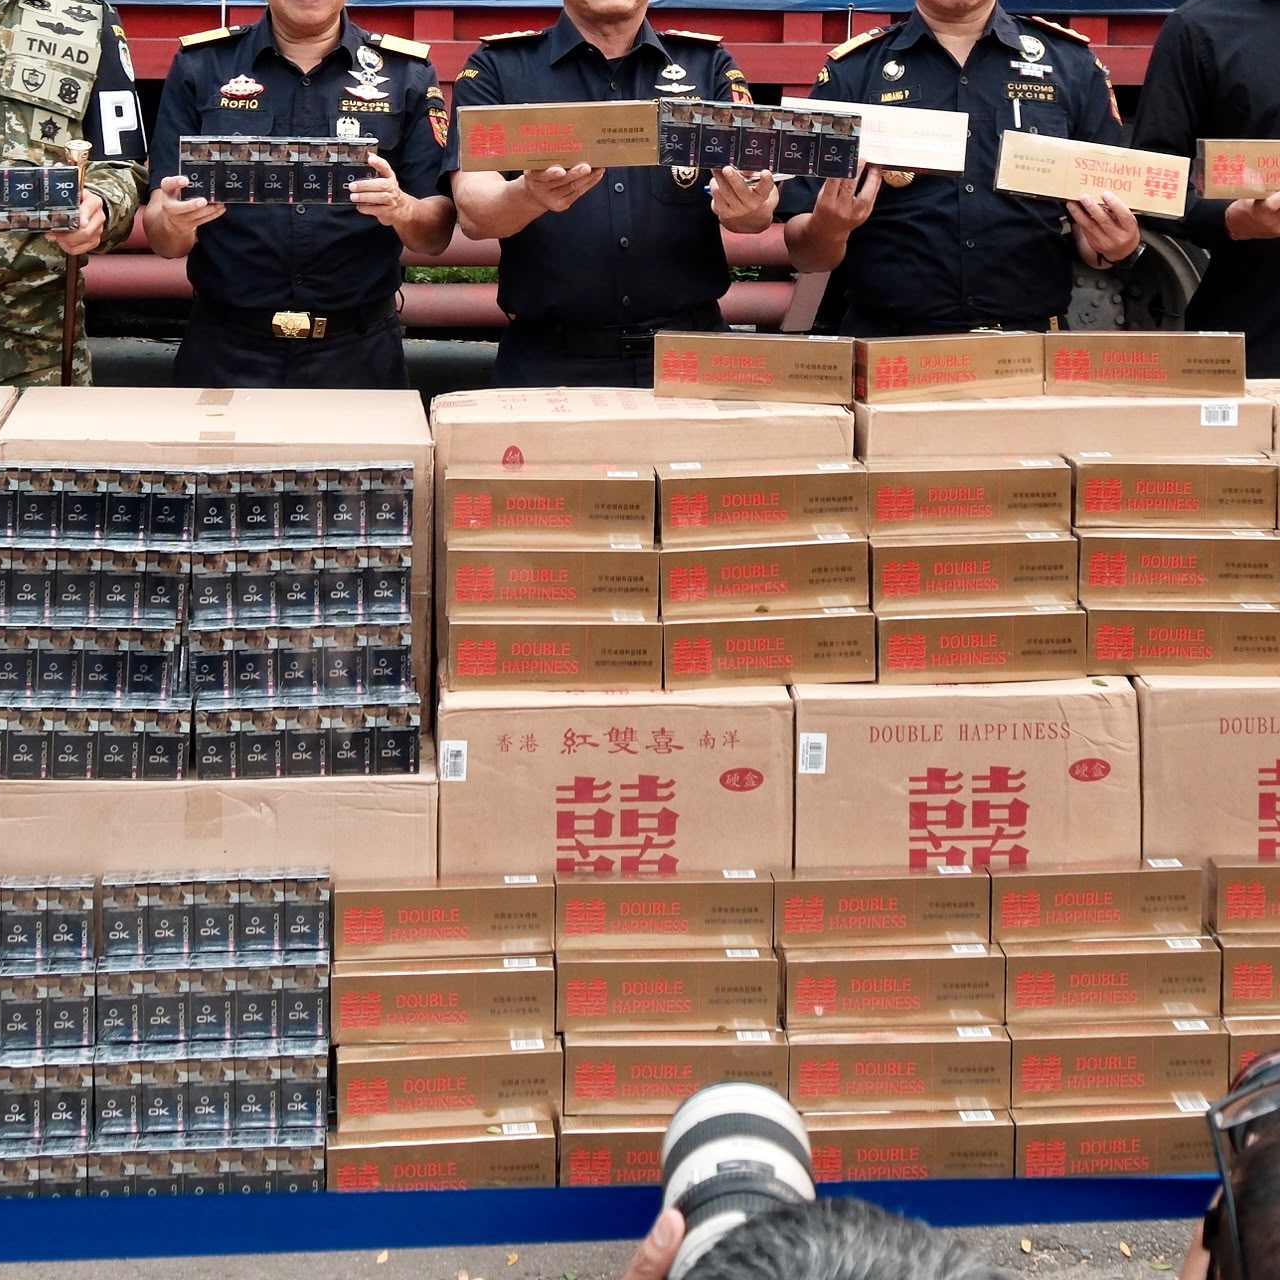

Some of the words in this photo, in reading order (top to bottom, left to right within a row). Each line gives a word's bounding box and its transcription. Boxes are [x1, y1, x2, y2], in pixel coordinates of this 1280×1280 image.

[26, 37, 57, 56] TNI
[61, 46, 90, 65] AD
[1007, 82, 1055, 93] CUSTOMS
[1008, 91, 1054, 100] EXCISE
[220, 97, 259, 109] ROFIQ
[98, 90, 148, 156] P
[1074, 156, 1142, 178] HAPPINESS
[1079, 172, 1132, 193] DOUBLE
[711, 354, 768, 370] DOUBLE
[702, 370, 776, 387] HAPPINESS
[505, 496, 565, 512] DOUBLE
[720, 491, 781, 508] DOUBLE
[495, 512, 574, 529] HAPPINESS
[712, 509, 789, 526] HAPPINESS
[1146, 626, 1205, 642] DOUBLE
[510, 641, 571, 657] DOUBLE
[1138, 644, 1213, 661] HAPPINESS
[502, 658, 579, 675] HAPPINESS
[868, 723, 944, 743] DOUBLE
[958, 721, 1072, 741] HAPPINESS
[496, 733, 539, 753] 香港
[559, 726, 684, 756] 紅雙喜
[699, 729, 741, 751] 南洋
[723, 770, 760, 789] 硬盒
[398, 906, 460, 924] DOUBLE
[388, 924, 470, 942] HAPPINESS
[621, 978, 683, 995] DOUBLE
[612, 997, 693, 1014] HAPPINESS
[853, 1060, 915, 1077] DOUBLE
[1075, 1054, 1137, 1071] DOUBLE
[844, 1077, 926, 1095] HAPPINESS
[1067, 1073, 1145, 1091] HAPPINESS
